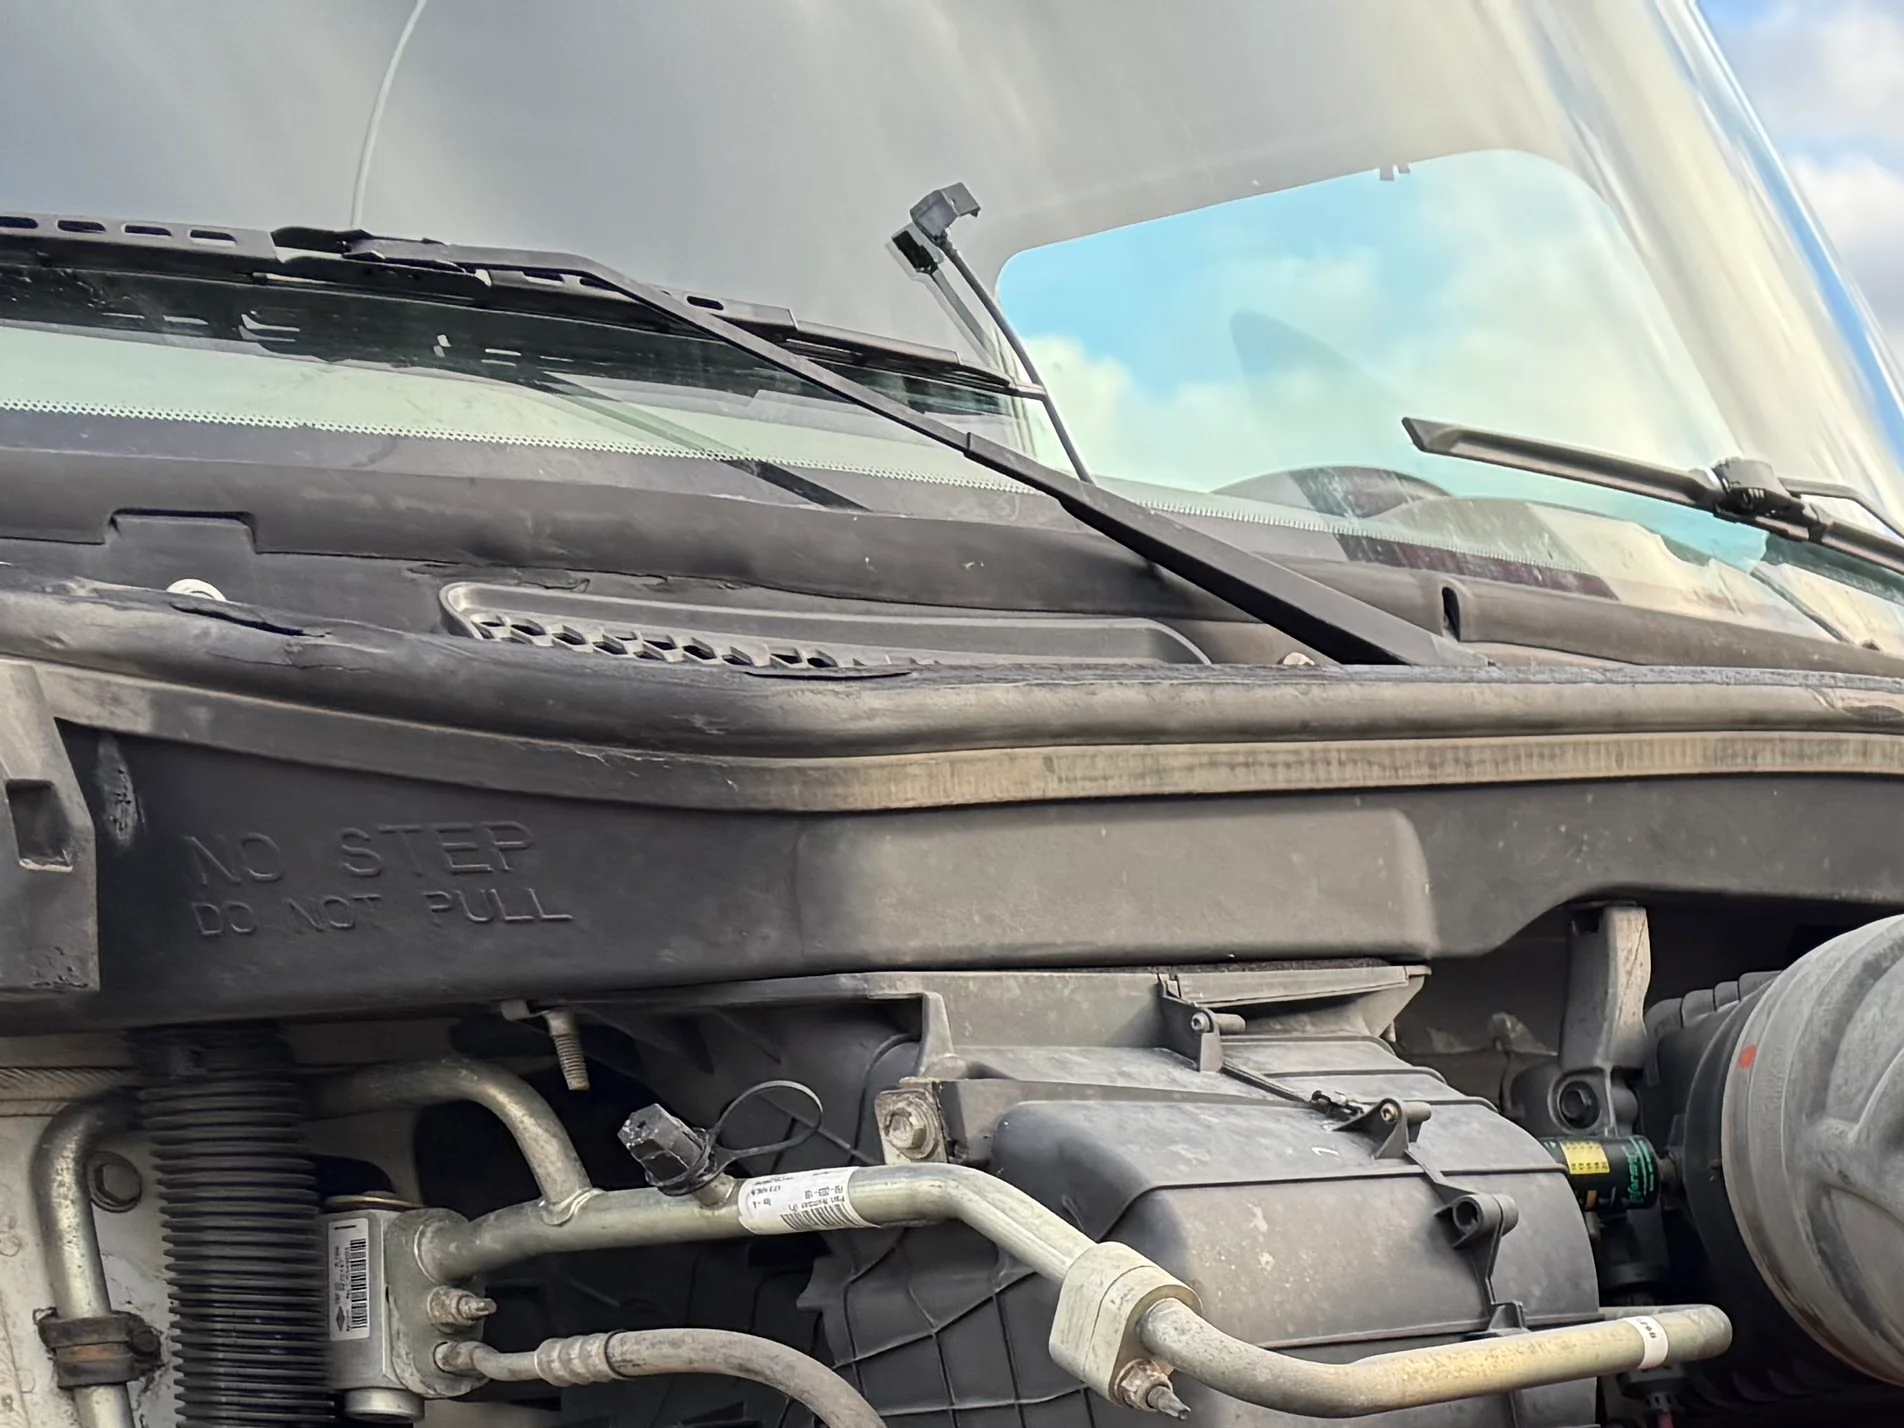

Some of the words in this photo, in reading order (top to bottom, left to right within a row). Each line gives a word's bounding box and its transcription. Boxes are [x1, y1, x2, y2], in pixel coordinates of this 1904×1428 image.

[184, 833, 283, 886] NO
[339, 821, 534, 878] STEP
[193, 901, 256, 935] DO
[288, 894, 381, 932] NOT
[423, 887, 574, 924] PULL
